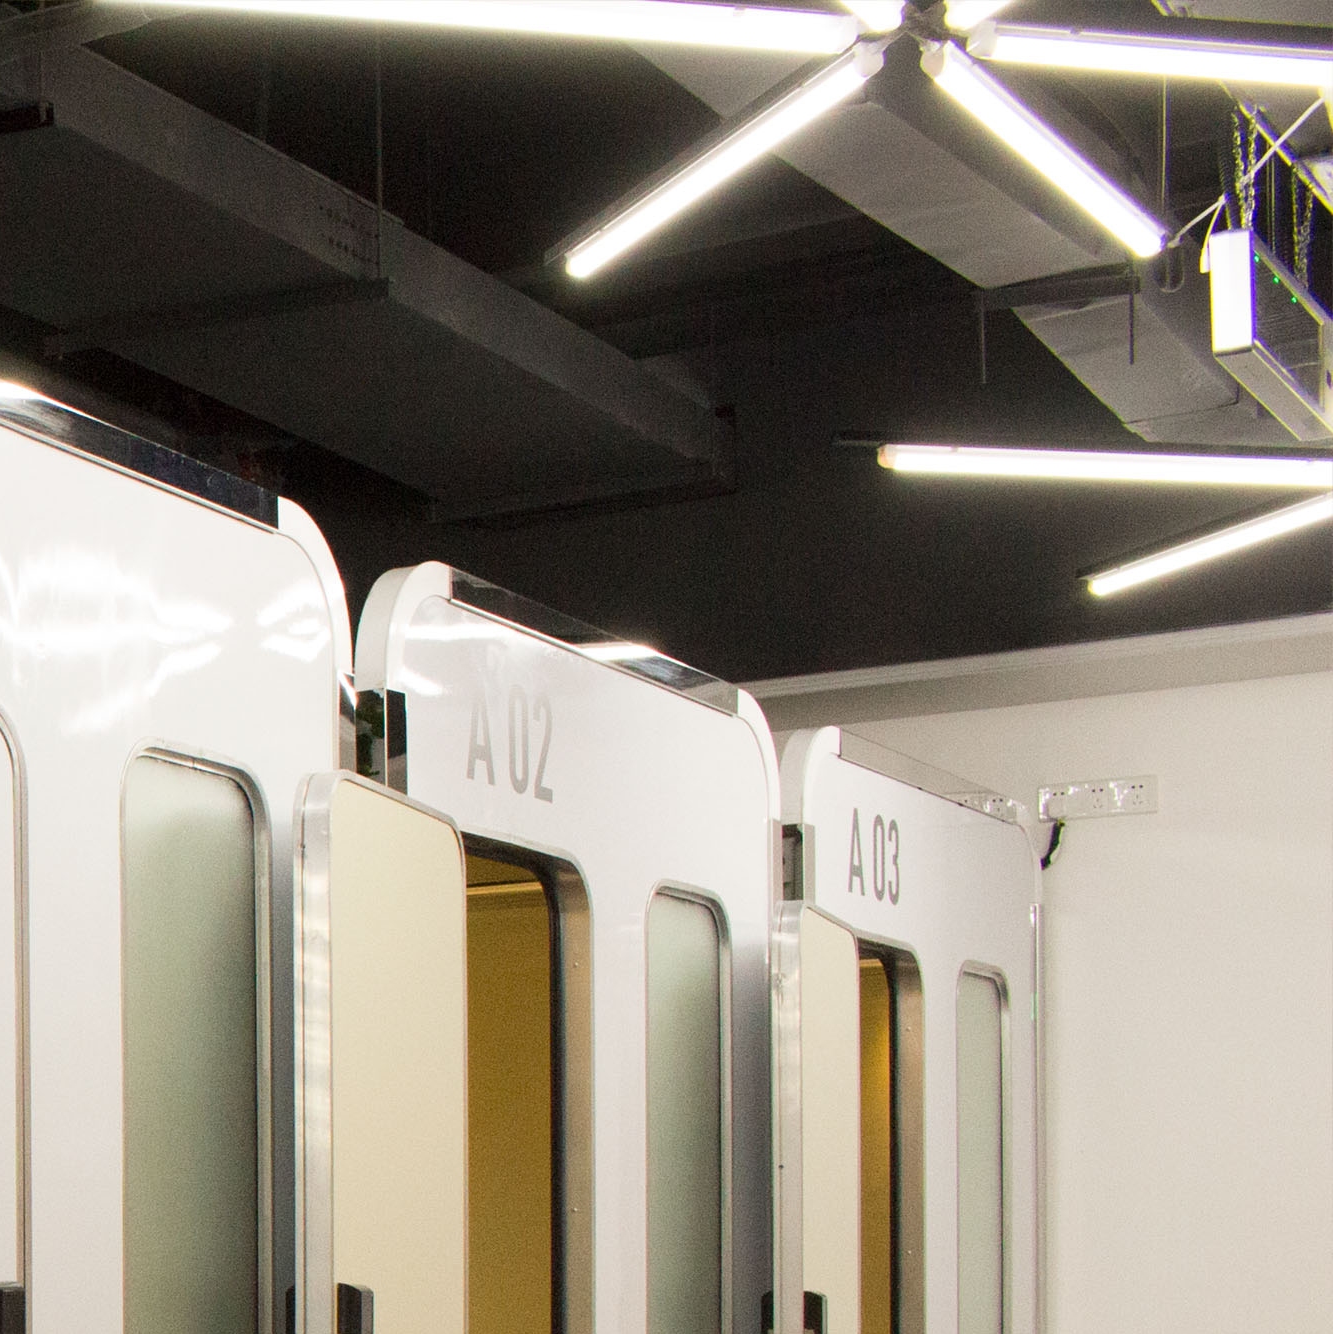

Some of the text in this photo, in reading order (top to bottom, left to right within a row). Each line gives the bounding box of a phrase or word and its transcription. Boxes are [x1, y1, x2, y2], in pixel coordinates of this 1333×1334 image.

[467, 684, 554, 804] A 02
[848, 807, 900, 906] A 03
